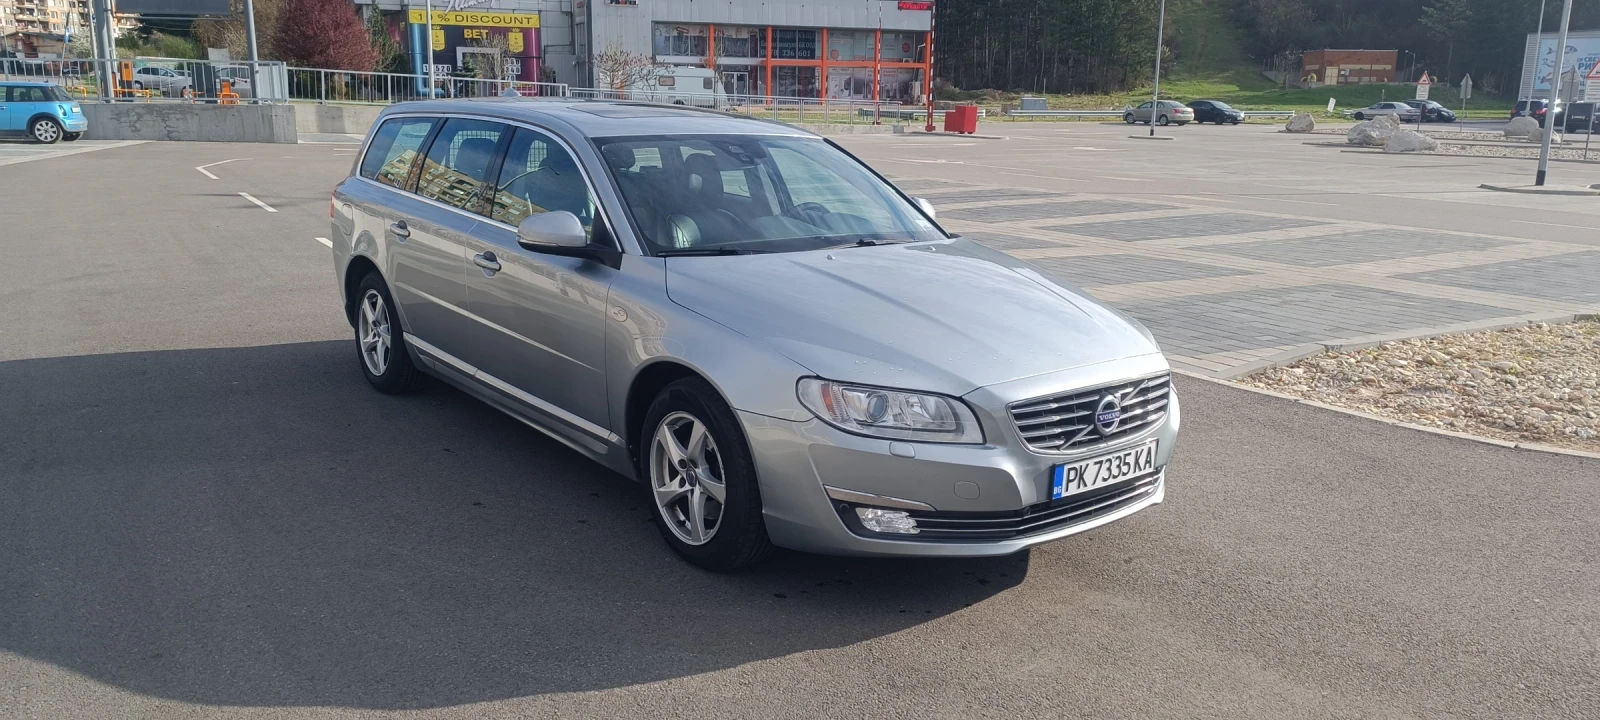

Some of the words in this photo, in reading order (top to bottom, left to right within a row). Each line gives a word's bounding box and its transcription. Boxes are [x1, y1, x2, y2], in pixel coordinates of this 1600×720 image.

[454, 15, 533, 25] DISCOUNT
[464, 29, 488, 38] BET
[1099, 411, 1120, 421] VOLVO
[1065, 463, 1090, 492] PK
[1092, 452, 1132, 485] 7335
[1133, 446, 1152, 474] KA
[1053, 485, 1062, 495] BG
